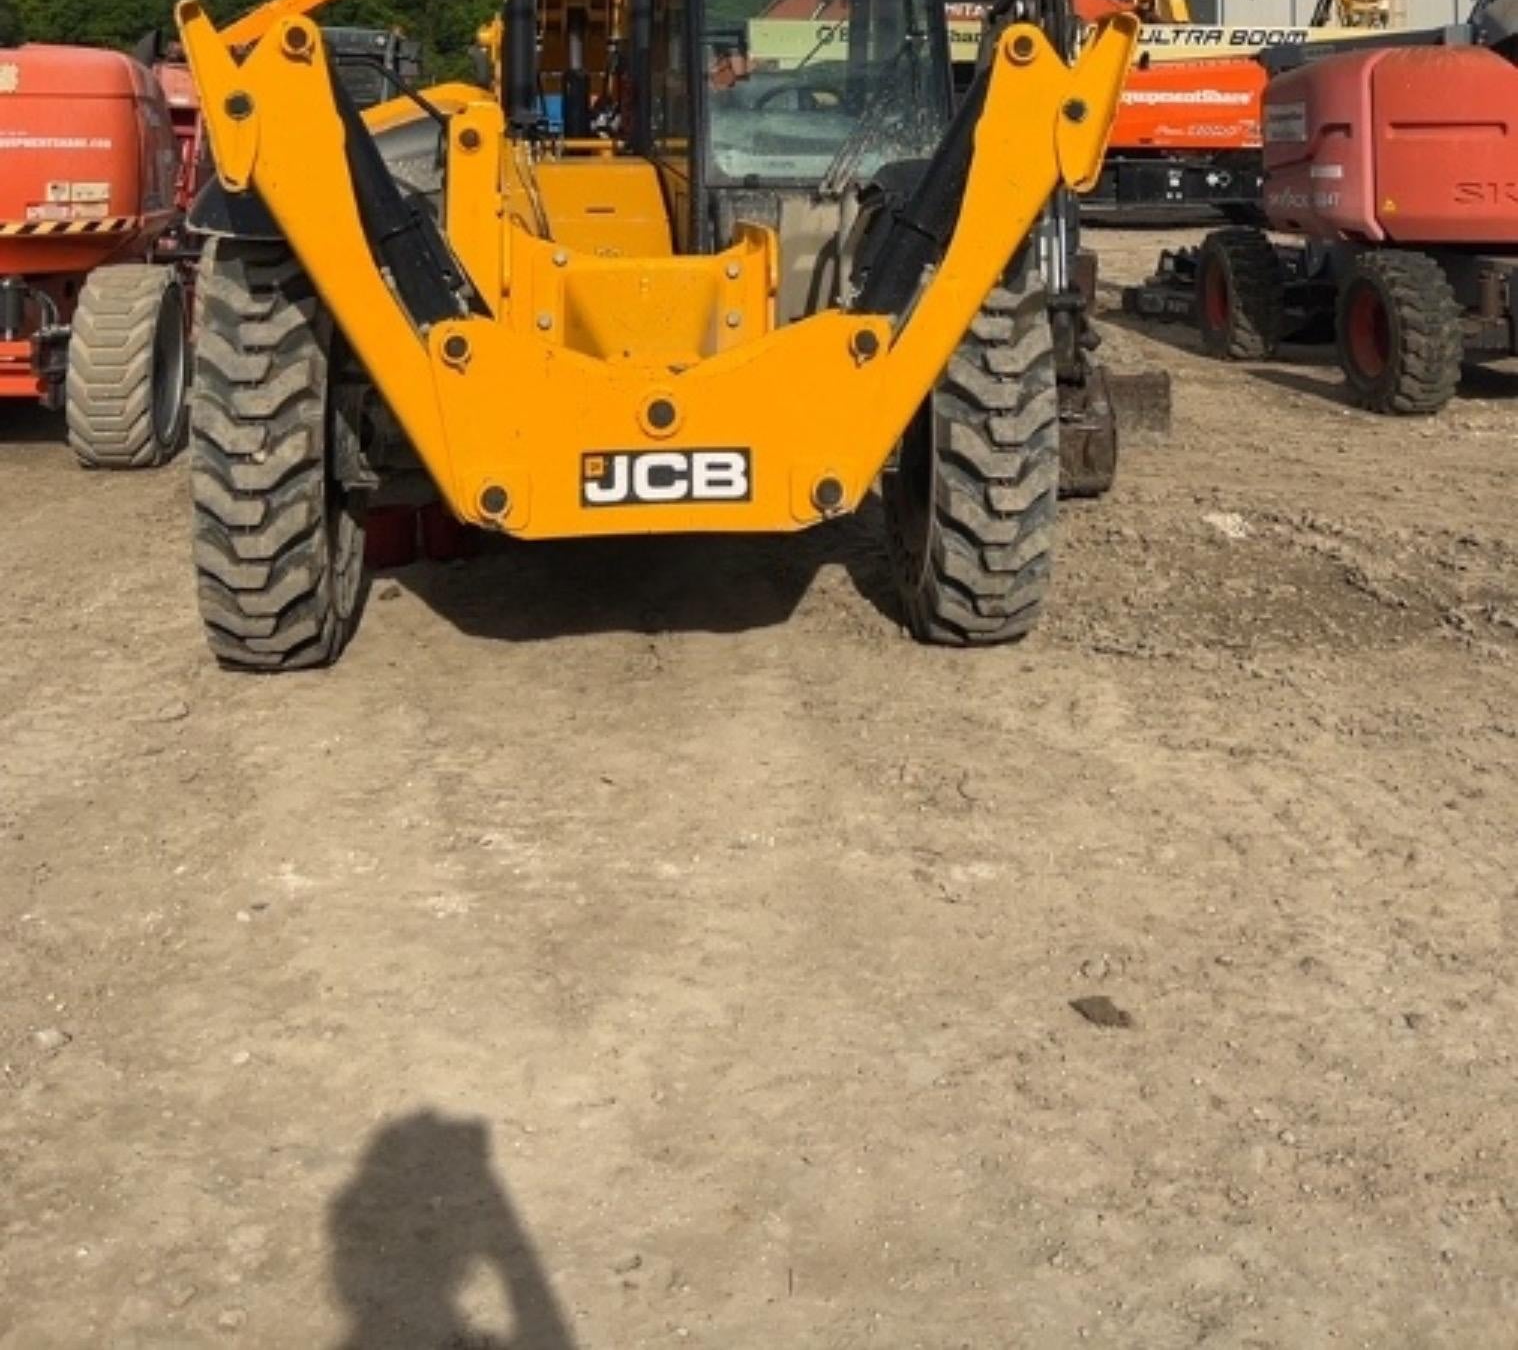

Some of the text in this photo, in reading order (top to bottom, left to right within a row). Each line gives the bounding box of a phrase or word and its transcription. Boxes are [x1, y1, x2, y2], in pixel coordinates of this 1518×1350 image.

[1137, 29, 1309, 46] ULTRA BOOM
[1120, 88, 1250, 106] quipmentShare
[583, 451, 748, 502] JCB
